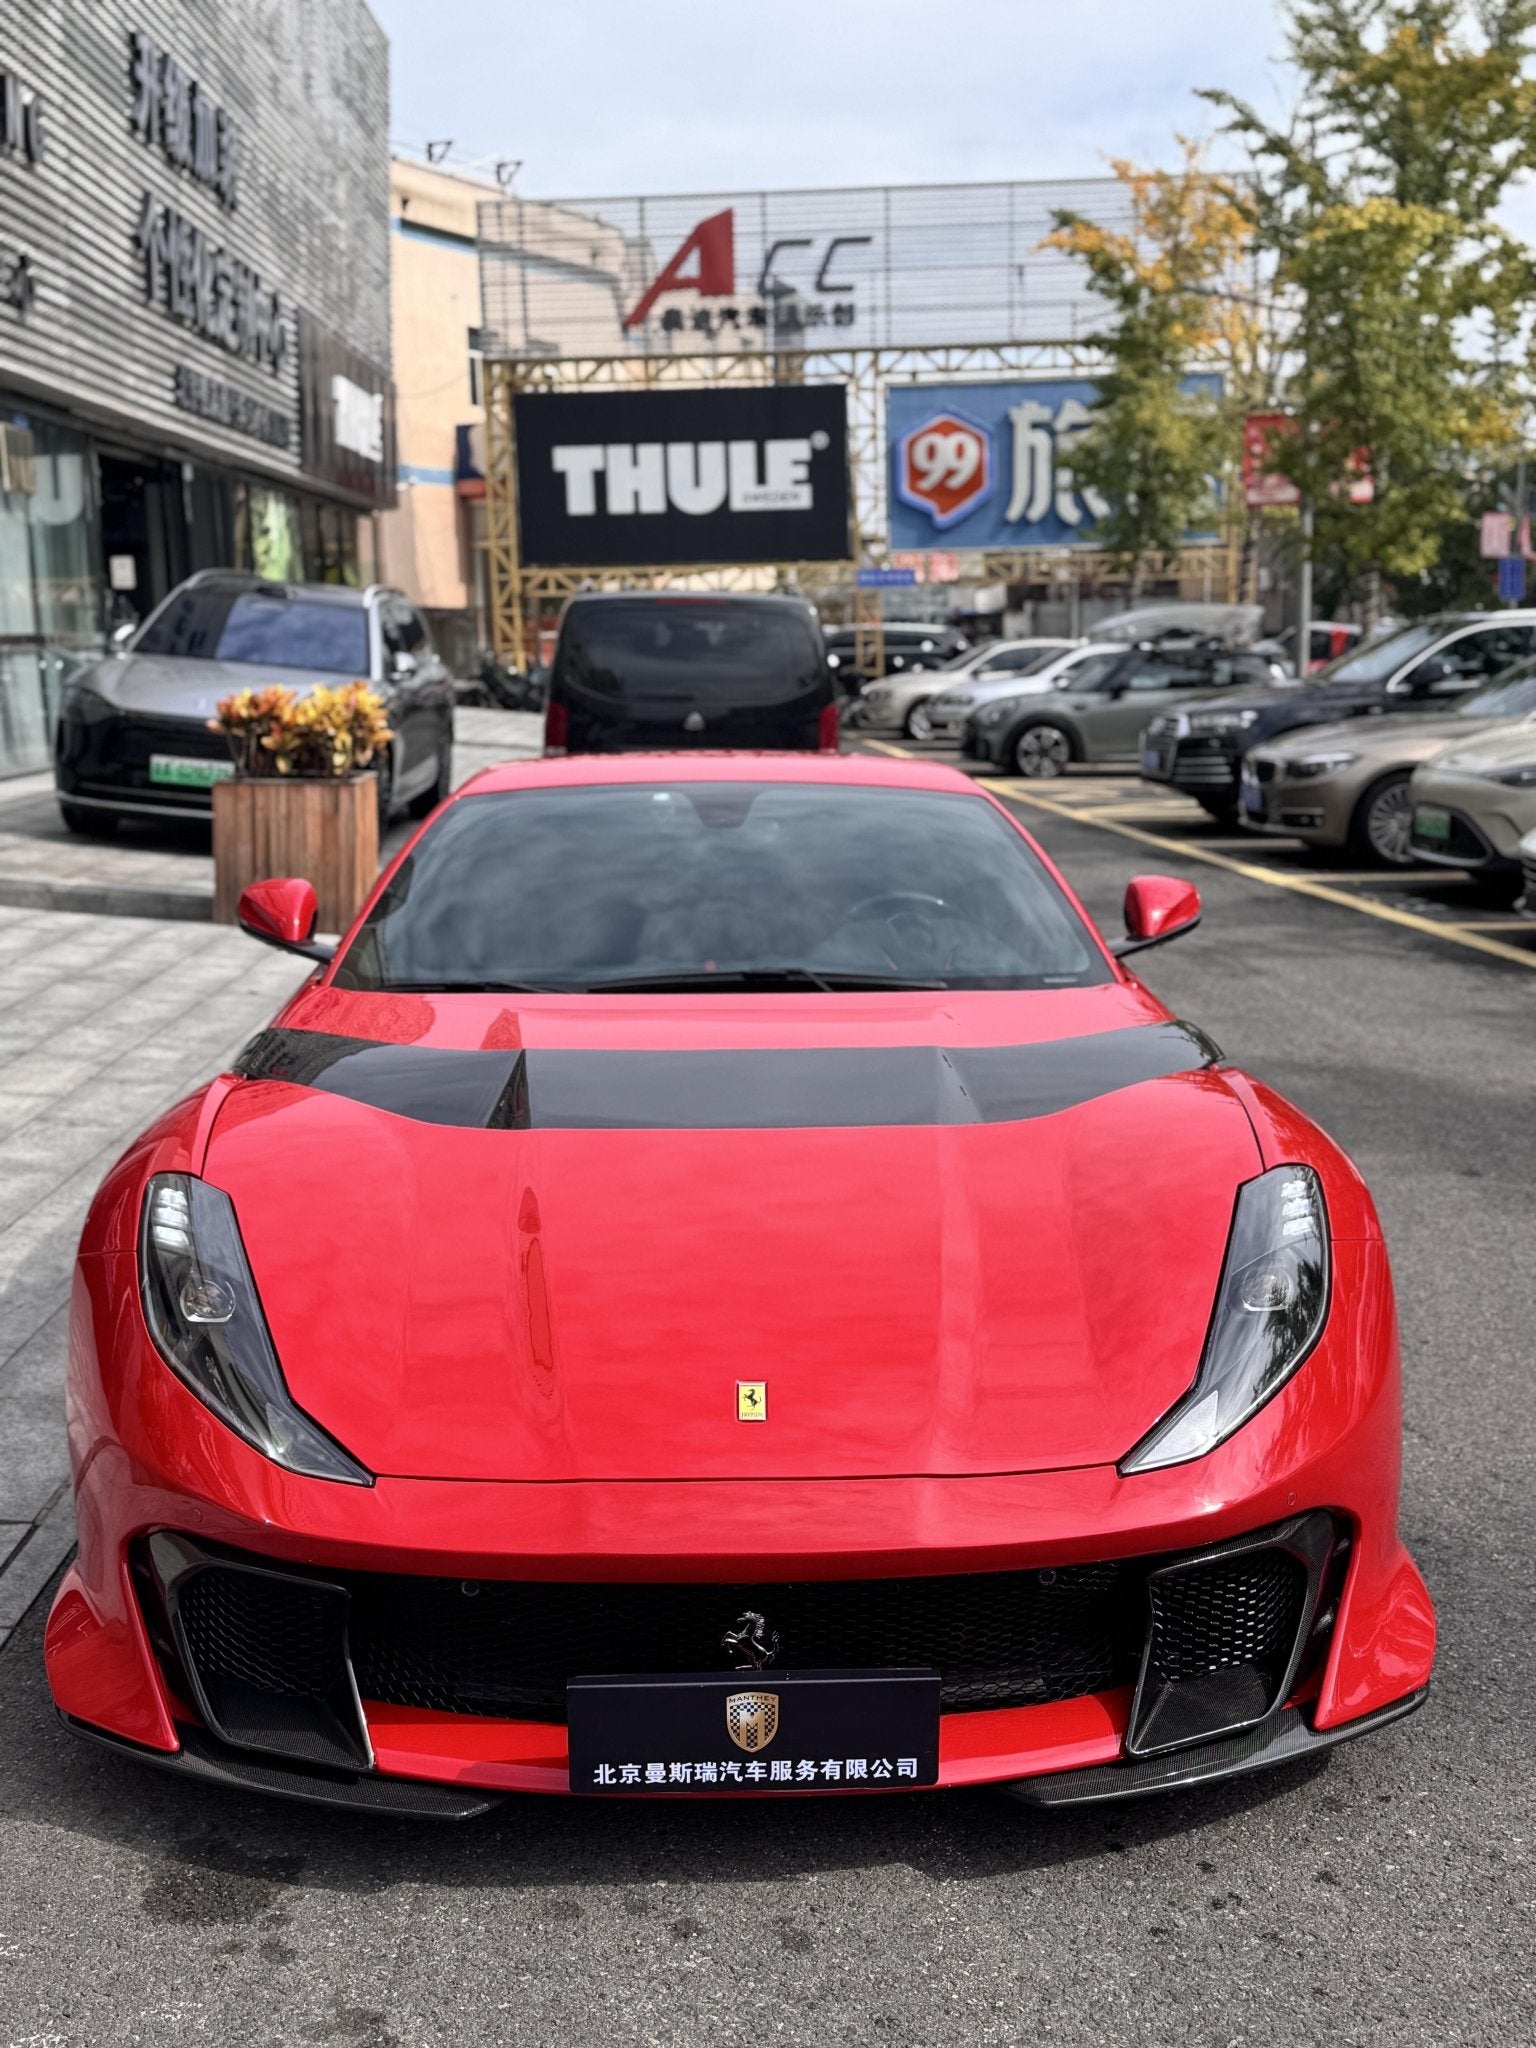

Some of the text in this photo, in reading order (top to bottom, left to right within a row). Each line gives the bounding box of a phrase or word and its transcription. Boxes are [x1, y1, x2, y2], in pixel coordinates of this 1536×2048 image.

[551, 439, 813, 516] THULE
[911, 432, 981, 491] 99
[728, 1695, 777, 1704] MANTHEY
[593, 1757, 918, 1785] 北京曼斯瑞汽车服务有限公司
